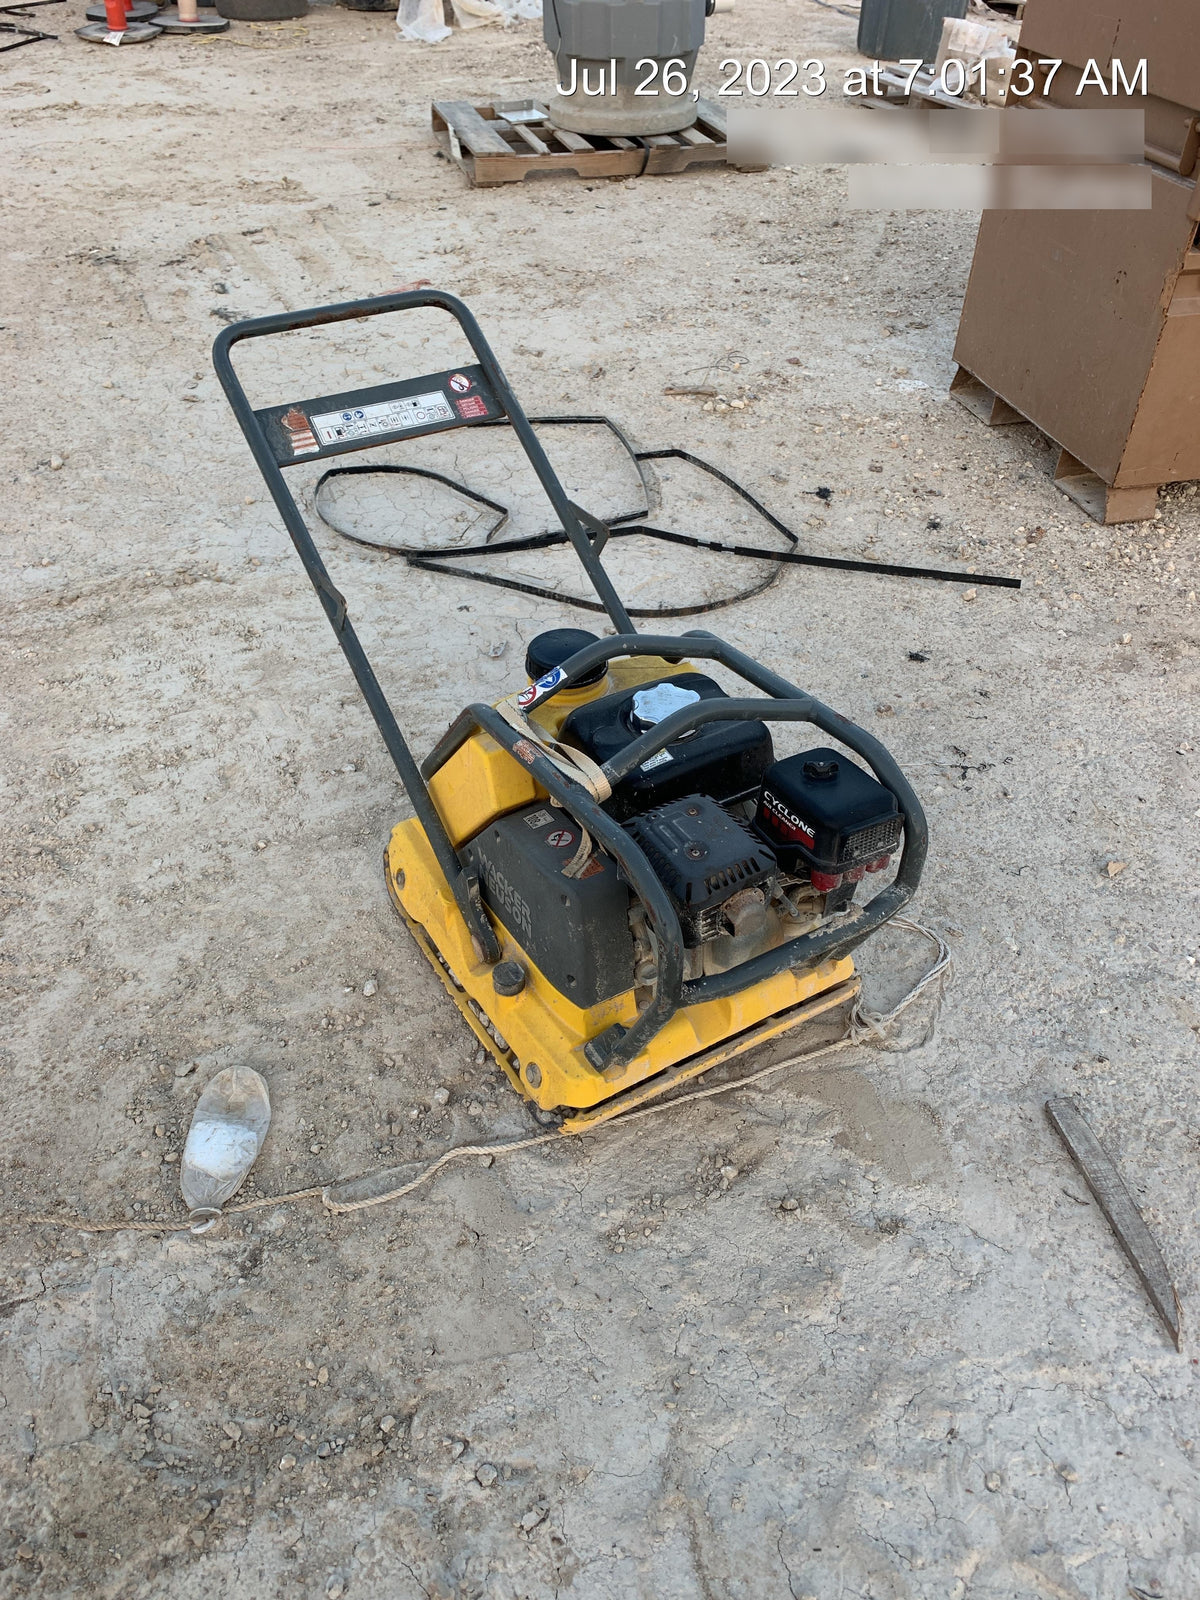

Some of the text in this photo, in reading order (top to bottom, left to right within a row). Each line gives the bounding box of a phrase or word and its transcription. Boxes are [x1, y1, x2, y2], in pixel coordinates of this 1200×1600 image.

[763, 790, 816, 838] CYCLONE
[771, 808, 797, 831] CLEANER
[477, 847, 532, 924] WACKER
[479, 863, 532, 939] NEUSON
